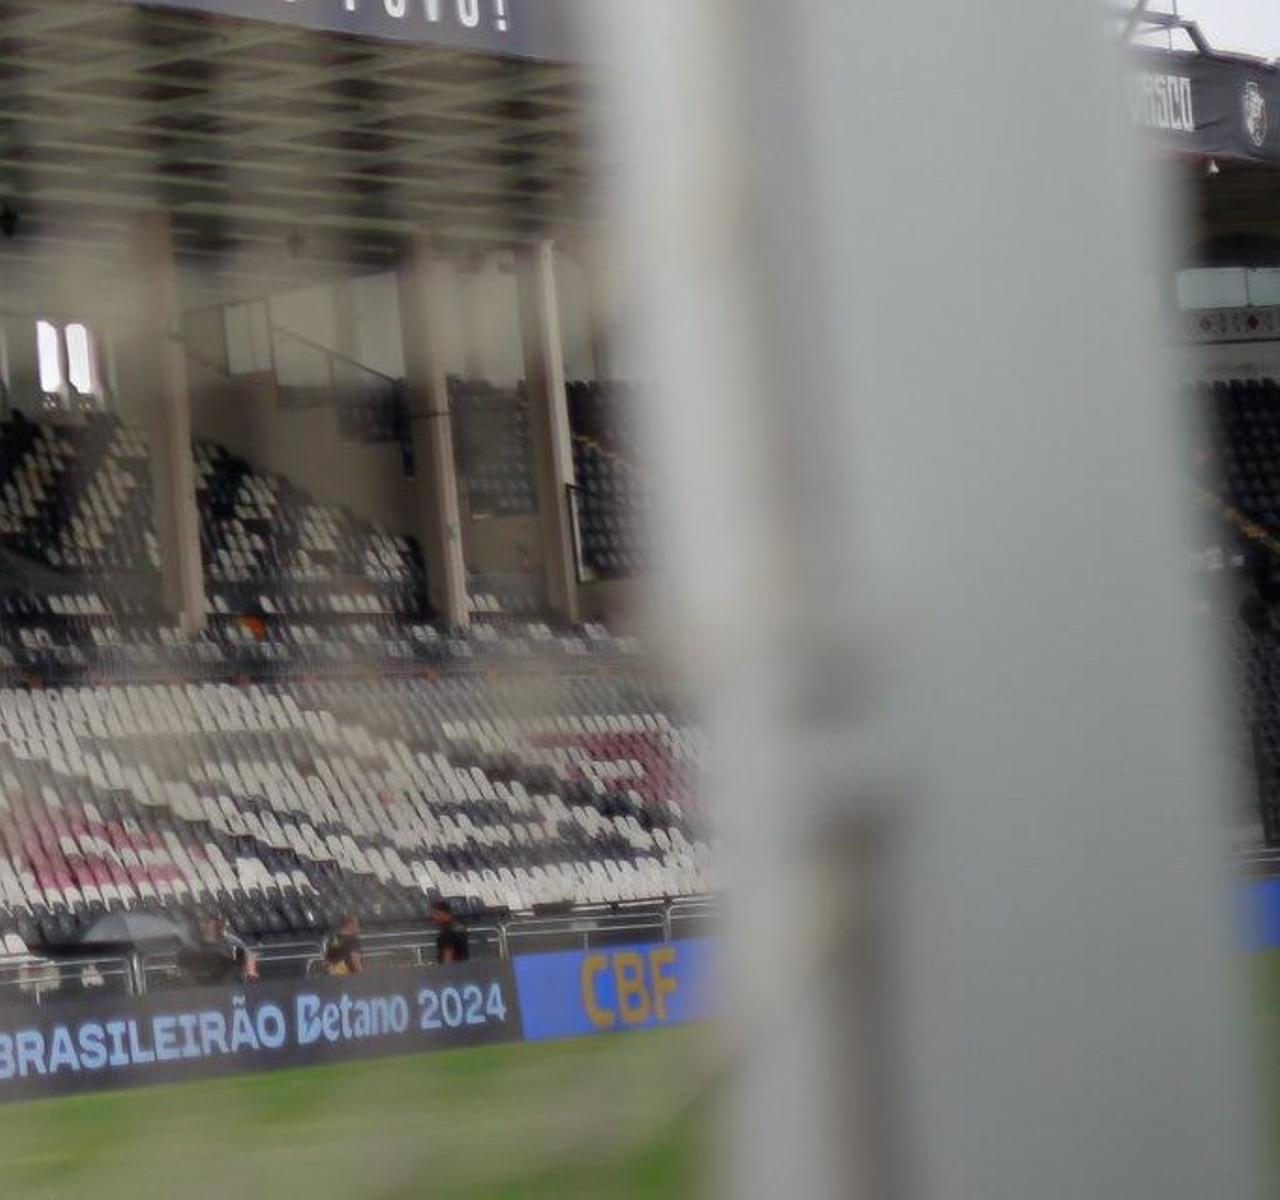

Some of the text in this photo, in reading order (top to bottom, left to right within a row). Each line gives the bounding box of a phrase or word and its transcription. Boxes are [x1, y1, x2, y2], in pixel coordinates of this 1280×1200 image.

[1128, 71, 1195, 133] ASCO
[297, 993, 409, 1047] Betano
[419, 983, 508, 1032] 2024
[579, 947, 679, 1029] CBF
